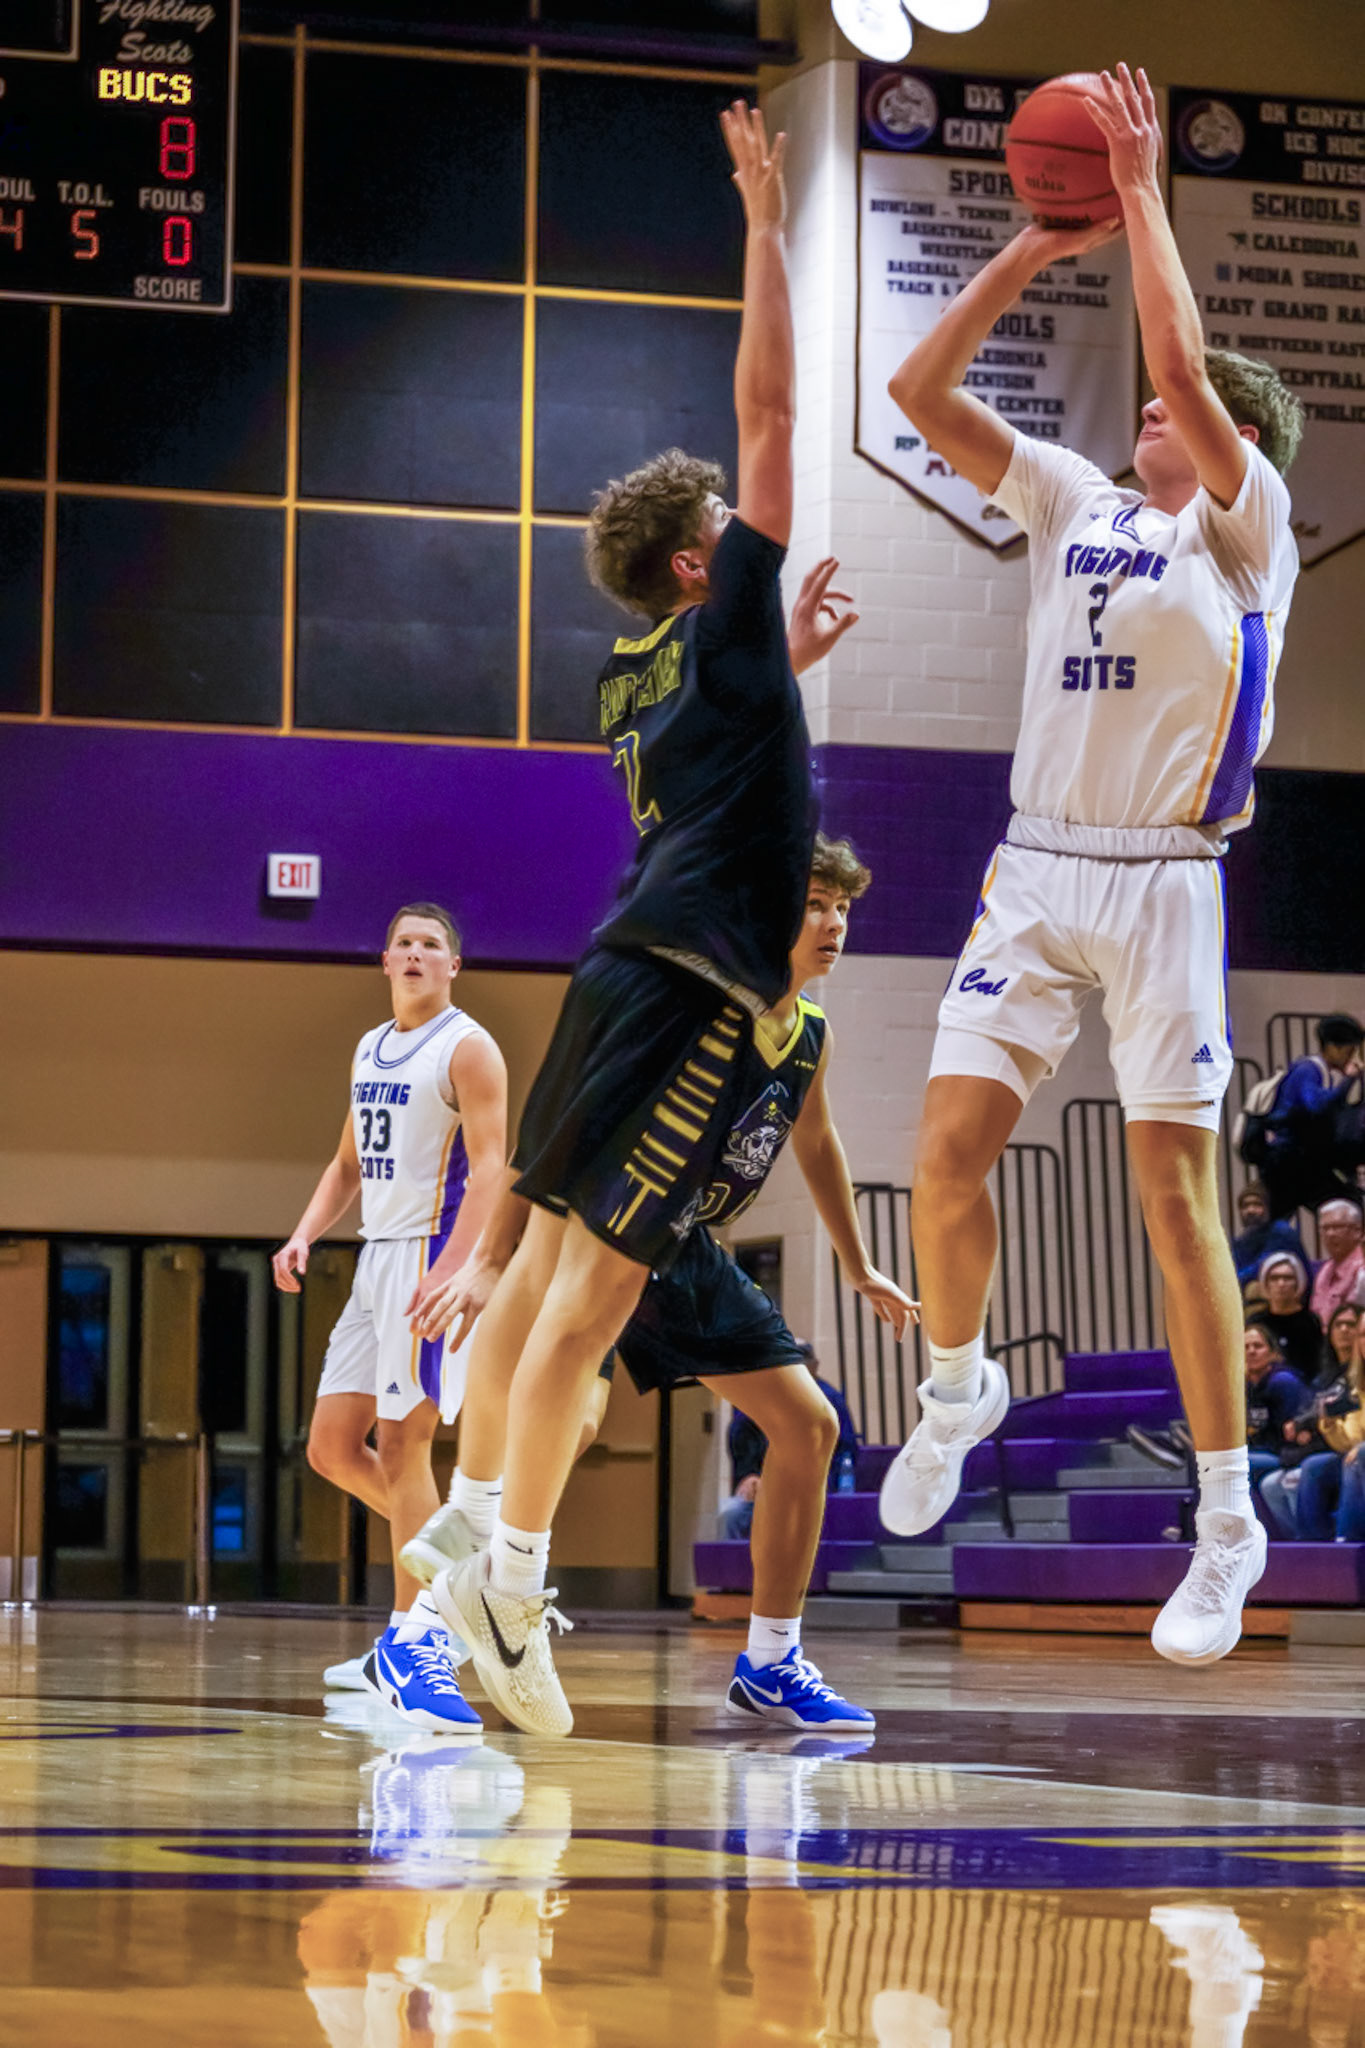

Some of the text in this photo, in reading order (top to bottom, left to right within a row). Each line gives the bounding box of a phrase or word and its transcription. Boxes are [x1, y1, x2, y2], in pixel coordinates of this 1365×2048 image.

[116, 31, 194, 64] Scots
[98, 68, 192, 105] BUCS
[160, 116, 196, 179] 8
[138, 187, 206, 213] FOULS
[1252, 191, 1361, 224] SCHOOLS
[71, 210, 100, 259] 5
[163, 217, 193, 265] 0
[1253, 233, 1359, 259] CALEDONIA
[135, 276, 202, 302] SCORE
[1237, 265, 1294, 287] MONA
[1205, 296, 1254, 317] EAST
[996, 395, 1065, 416] CENTER
[278, 862, 312, 889] EXIT
[360, 1108, 391, 1153] 33
